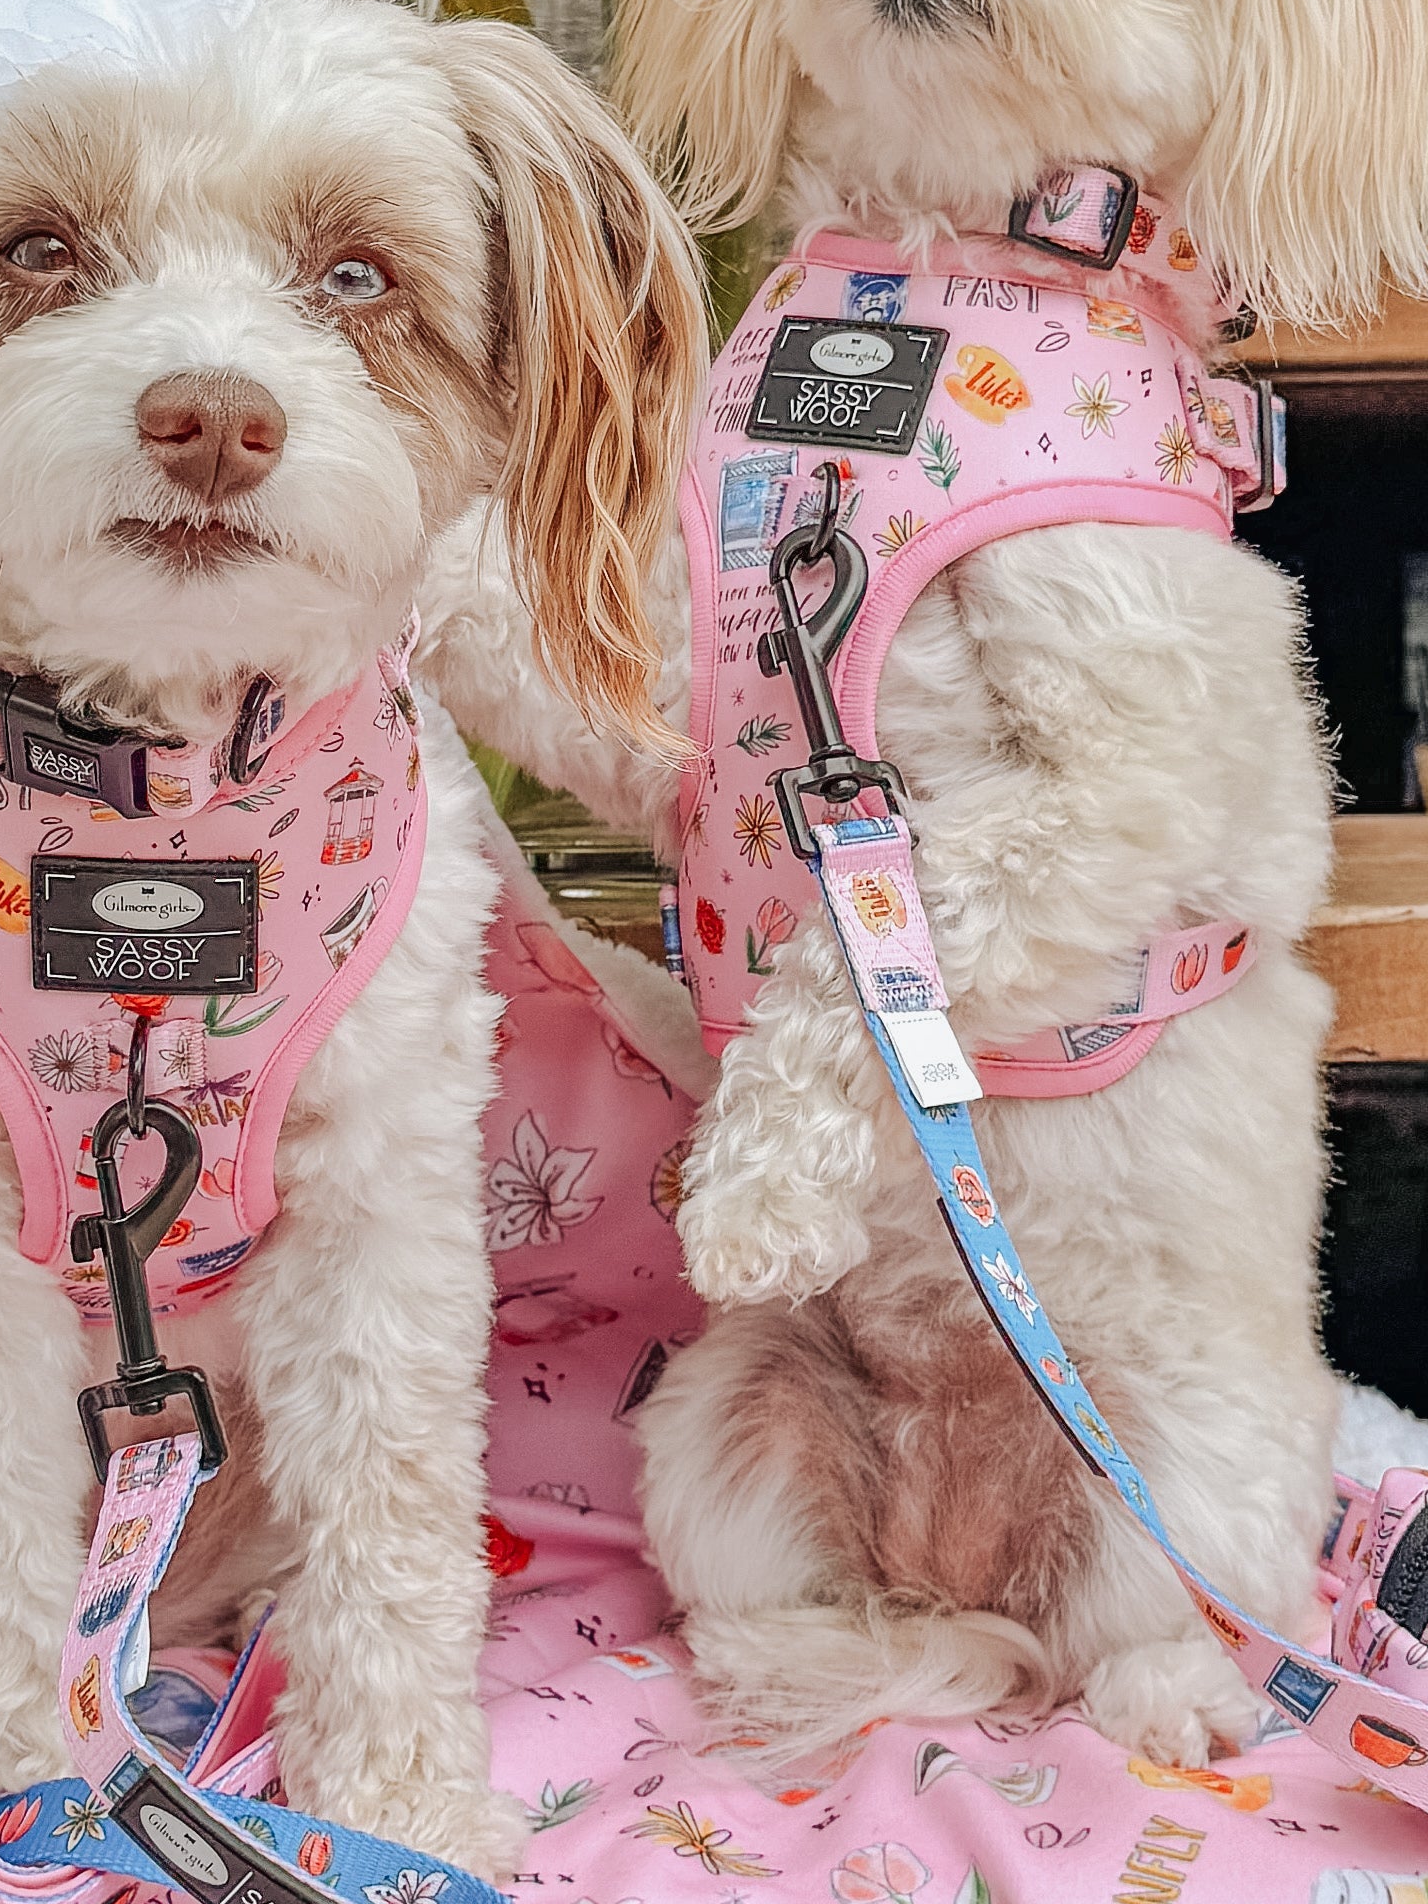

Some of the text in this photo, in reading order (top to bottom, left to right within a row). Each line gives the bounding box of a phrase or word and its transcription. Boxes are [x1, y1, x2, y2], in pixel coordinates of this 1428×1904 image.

[798, 380, 883, 407] SASSY
[789, 399, 871, 428] WOOF
[30, 746, 96, 775] SASSY
[30, 760, 94, 785] WOOF
[103, 895, 196, 920] Gilmore girls
[94, 936, 207, 962] SASSY
[87, 956, 200, 982] WOOF
